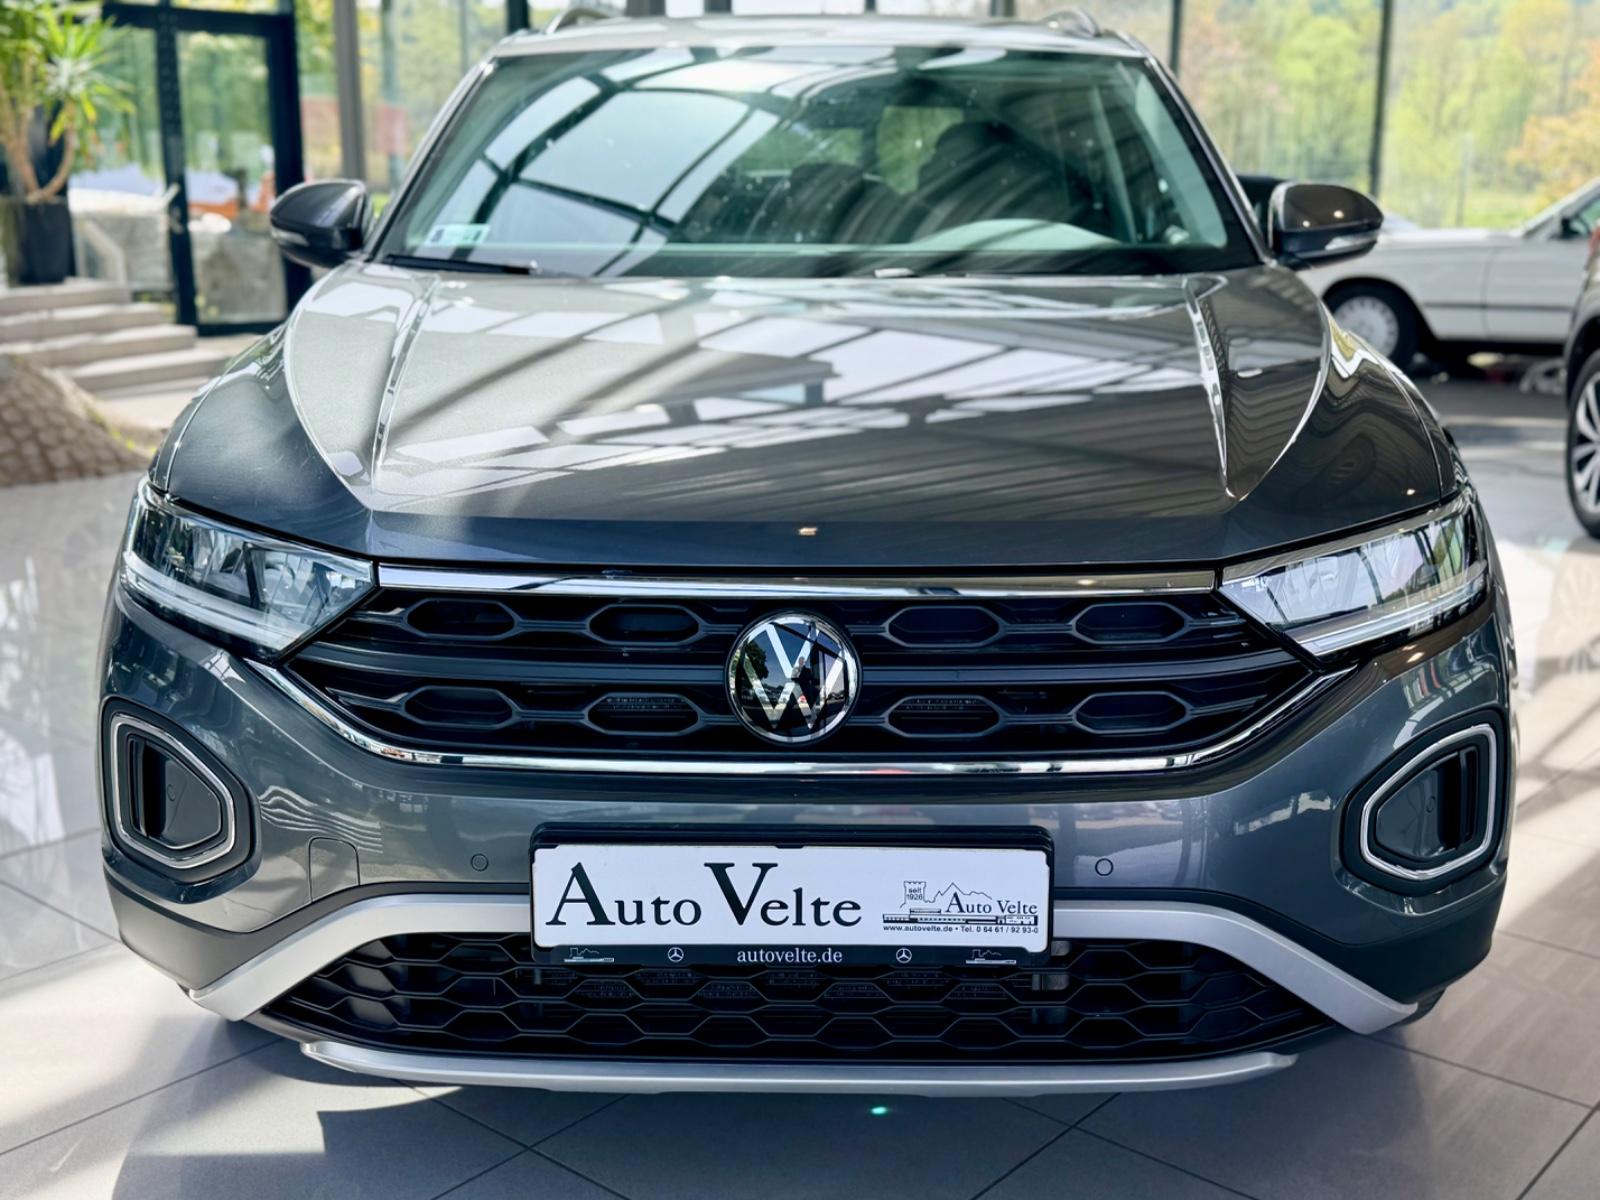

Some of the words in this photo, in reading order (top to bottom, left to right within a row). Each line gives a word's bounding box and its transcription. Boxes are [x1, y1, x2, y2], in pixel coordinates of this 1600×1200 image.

[545, 862, 701, 927] Auto
[703, 862, 862, 927] Velte
[908, 886, 922, 894] seit
[905, 893, 923, 901] 1926
[945, 892, 992, 914] Auto
[997, 900, 1038, 915] Velte
[960, 925, 974, 933] Tel.
[1011, 926, 1020, 934] 92
[737, 947, 843, 964] autovelte.de
